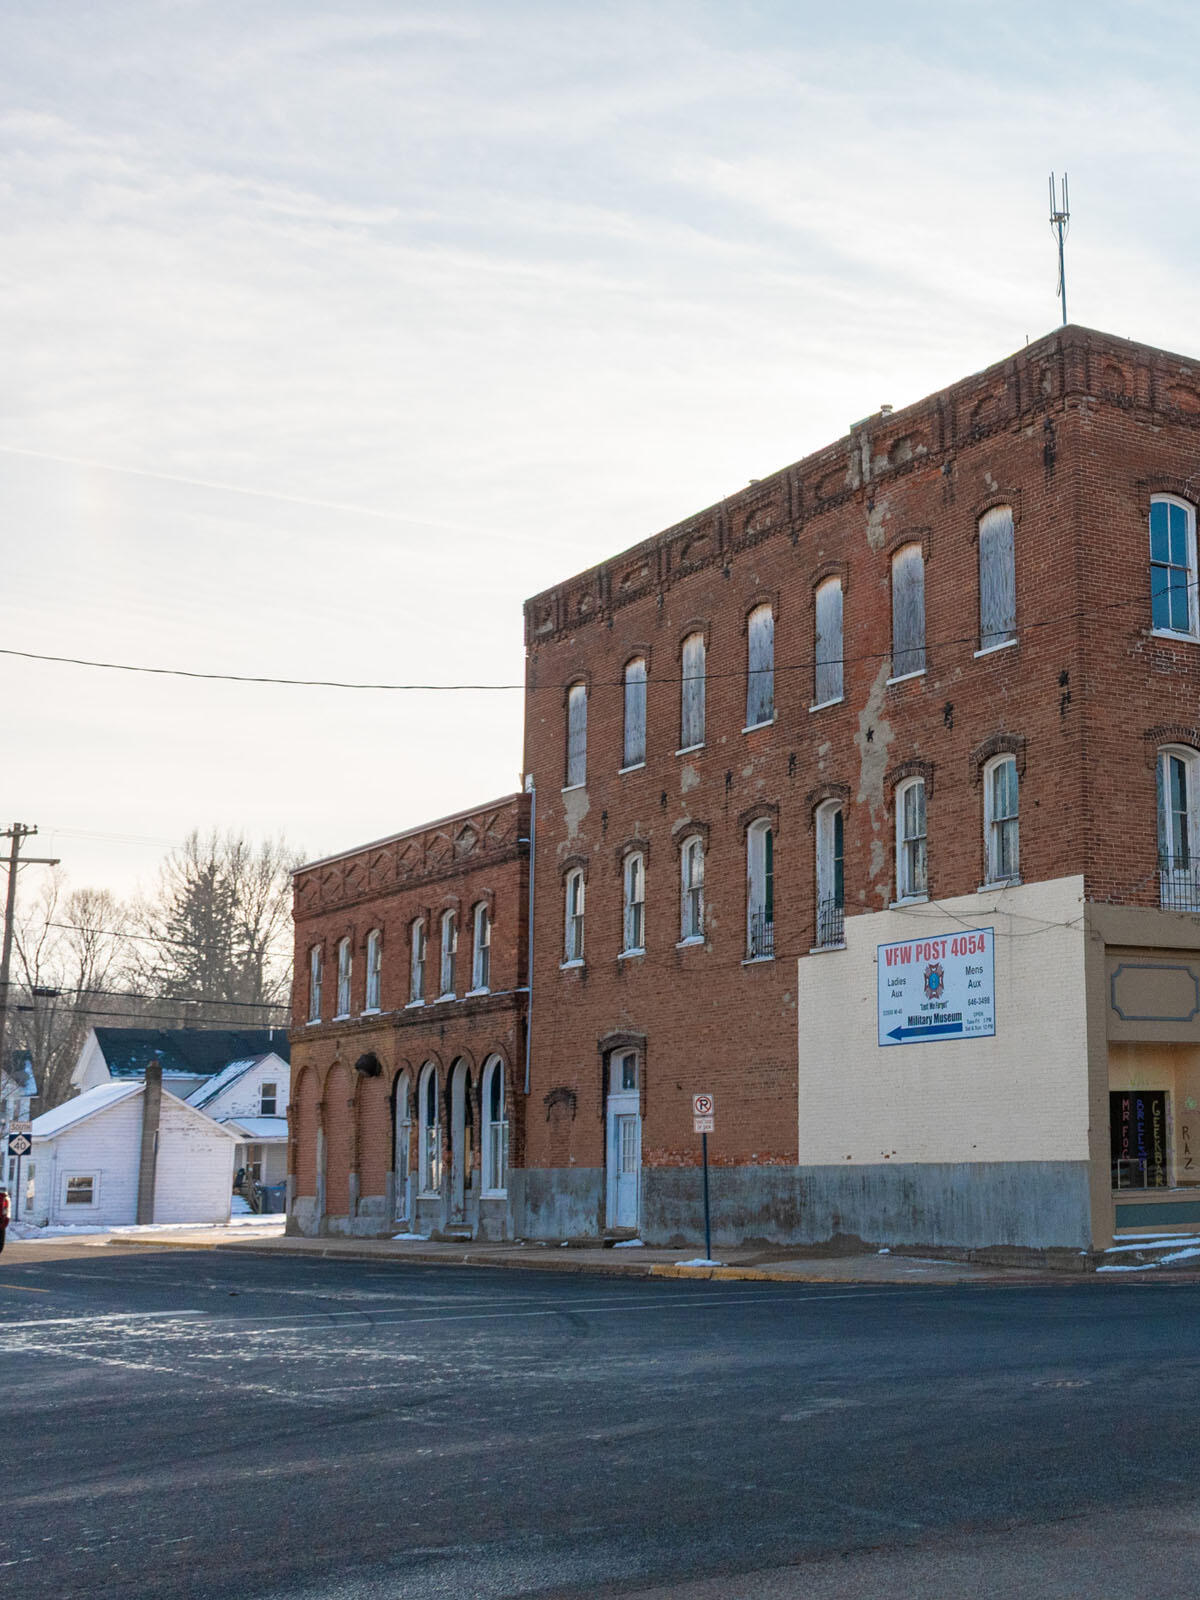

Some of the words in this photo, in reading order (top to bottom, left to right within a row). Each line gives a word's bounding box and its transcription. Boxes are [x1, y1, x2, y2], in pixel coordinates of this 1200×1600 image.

[885, 945, 912, 967] VFW
[915, 940, 947, 962] POST
[951, 934, 986, 957] 4054
[965, 965, 984, 975] Mens
[887, 977, 907, 987] Ladies
[968, 979, 981, 989] Aux
[891, 990, 903, 998] Aux
[907, 1015, 932, 1026] Military
[934, 1012, 962, 1023] Museum
[1122, 1099, 1131, 1121] MR
[14, 1142, 26, 1150] 40
[1182, 1126, 1195, 1170] RAZ
